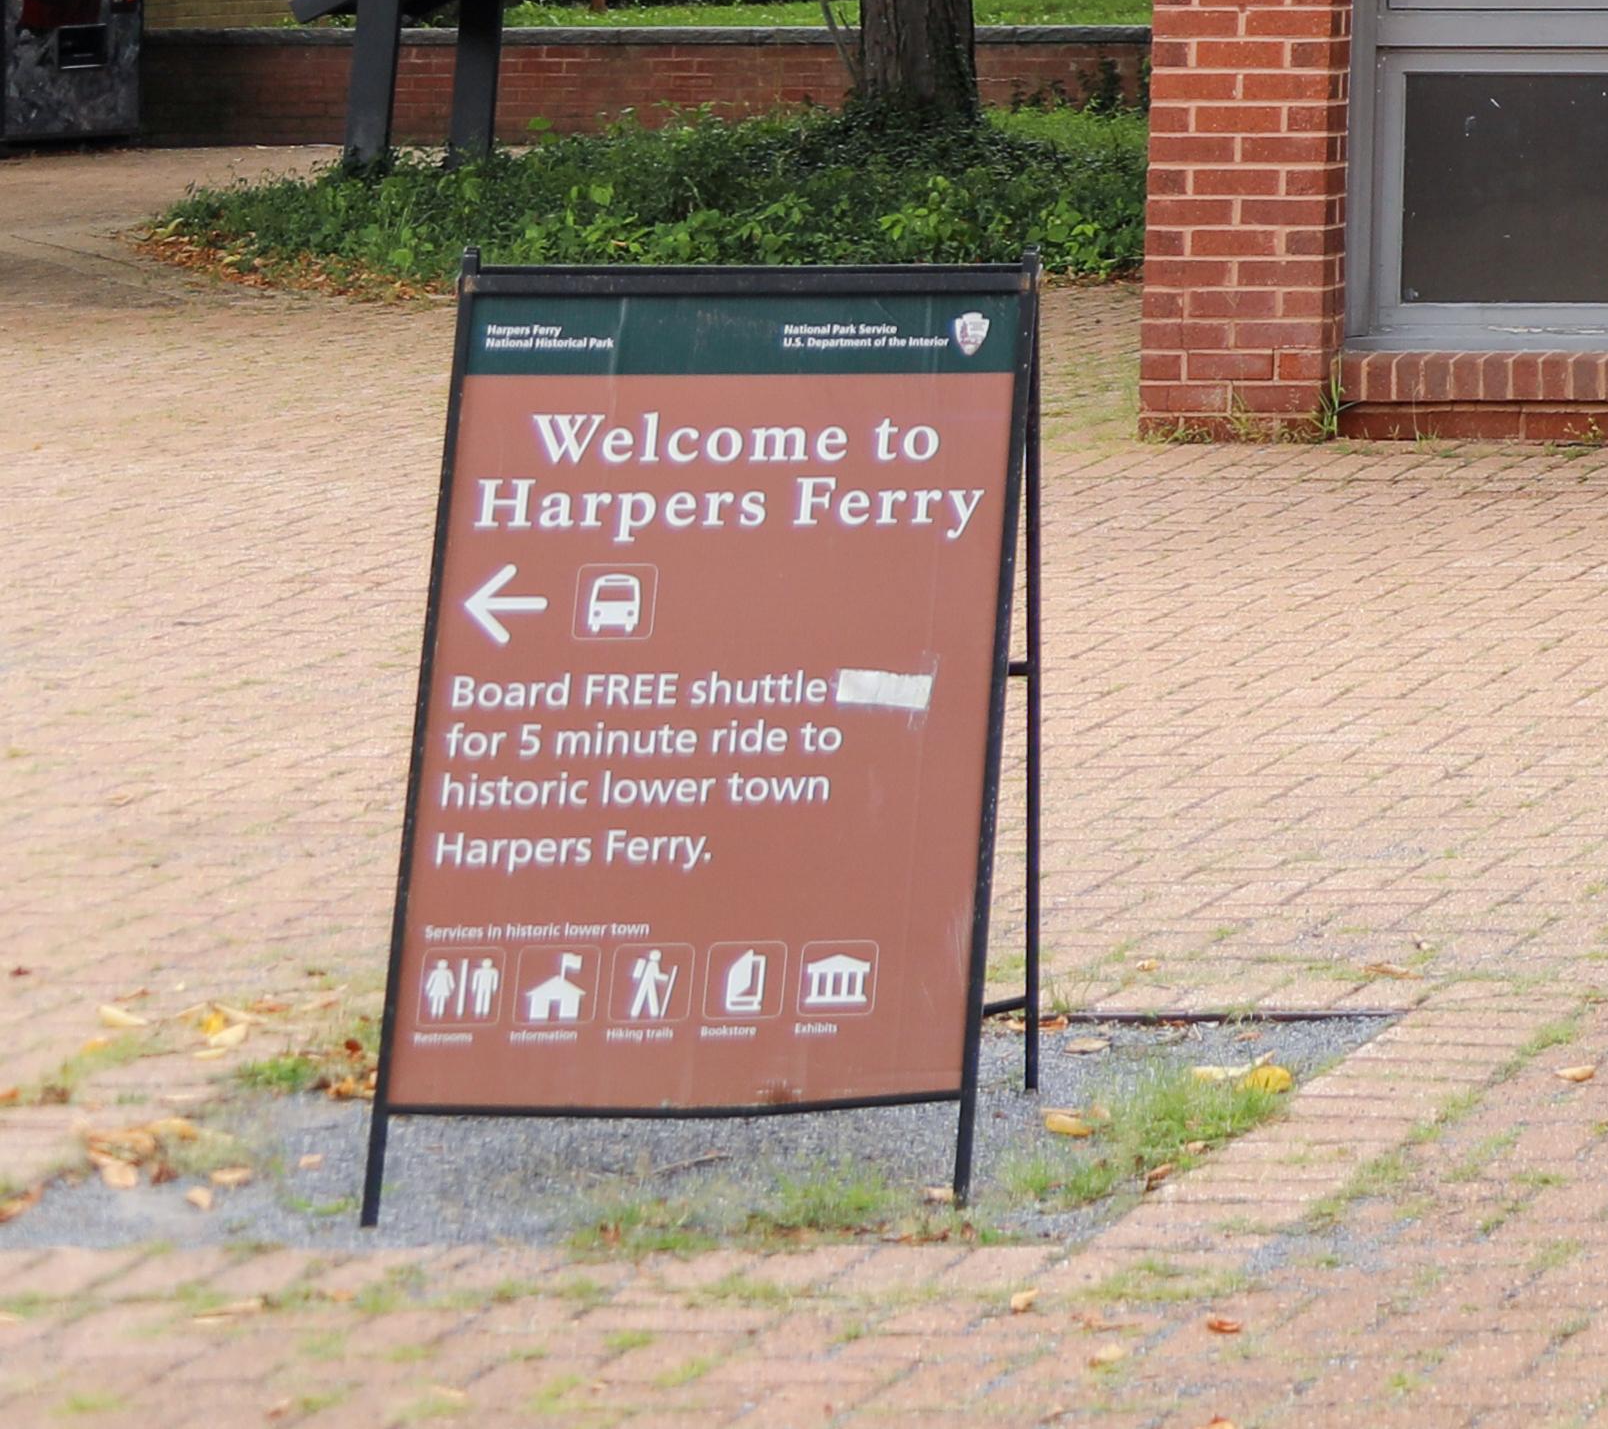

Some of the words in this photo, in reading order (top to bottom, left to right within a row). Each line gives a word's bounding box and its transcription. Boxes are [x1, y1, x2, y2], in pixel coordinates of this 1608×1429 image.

[486, 324, 530, 337] Harpers
[532, 324, 563, 337] Ferry
[784, 324, 830, 335] National
[832, 323, 856, 334] Park
[859, 323, 898, 334] Service
[485, 337, 533, 349] National
[535, 337, 587, 349] Historical
[588, 337, 615, 349] Park
[783, 337, 804, 347] U.S.
[807, 336, 875, 350] Department
[876, 336, 888, 346] of
[889, 336, 906, 346] the
[908, 336, 950, 346] Interior
[533, 412, 848, 464] Welcome
[874, 418, 940, 462] to
[473, 478, 767, 543] Harpers
[793, 477, 985, 539] Ferry
[451, 673, 572, 709] Board
[584, 674, 679, 707] FREE
[690, 670, 828, 706] shuttle
[445, 723, 507, 759] for
[518, 724, 542, 758] 5
[555, 722, 698, 756] minute
[711, 719, 788, 754] ride
[800, 722, 843, 753] to
[440, 772, 589, 808] historic
[601, 771, 716, 806] lower
[727, 772, 831, 803] town
[434, 832, 592, 873] Harpers
[604, 830, 713, 871] Ferry.
[425, 925, 484, 941] Services
[487, 924, 502, 939] in
[506, 922, 560, 938] historic
[564, 921, 607, 937] lower
[611, 923, 651, 936] town
[510, 1029, 577, 1042] Information
[606, 1027, 643, 1042] Hiking
[645, 1027, 674, 1041] trails
[700, 1025, 757, 1038] Bookstore
[794, 1022, 838, 1035] Exhibits
[414, 1031, 473, 1044] Restrooms
